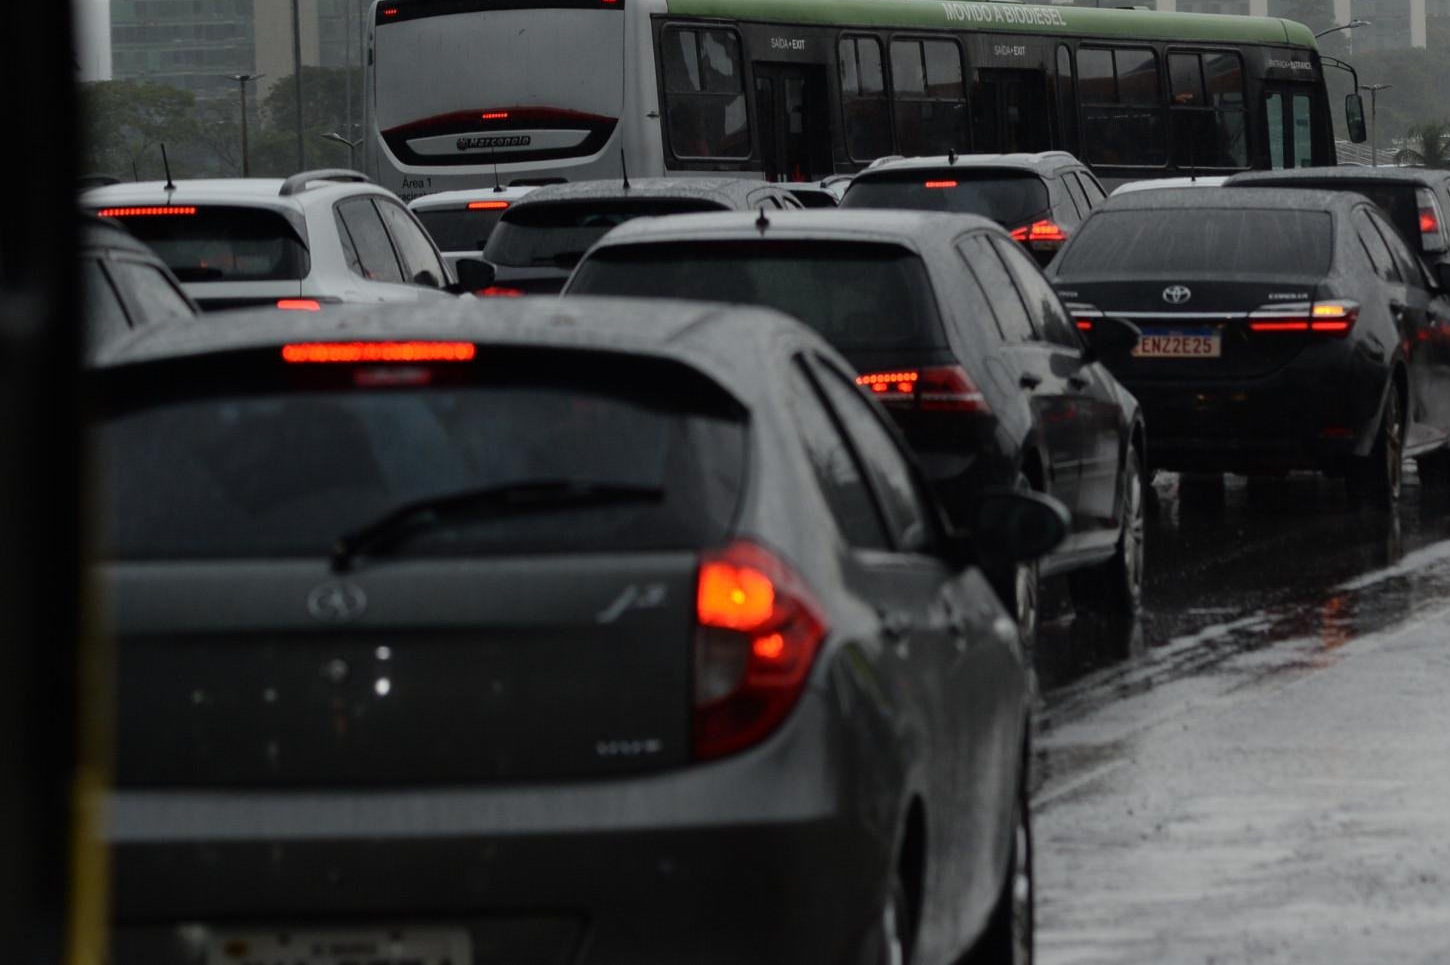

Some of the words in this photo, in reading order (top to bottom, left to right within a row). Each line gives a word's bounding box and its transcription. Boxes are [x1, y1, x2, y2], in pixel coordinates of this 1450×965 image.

[942, 3, 993, 23] MOVIDO
[1004, 6, 1068, 27] BIODIESEL
[402, 176, 425, 188] Área
[1141, 337, 1213, 354] ENZ2E25
